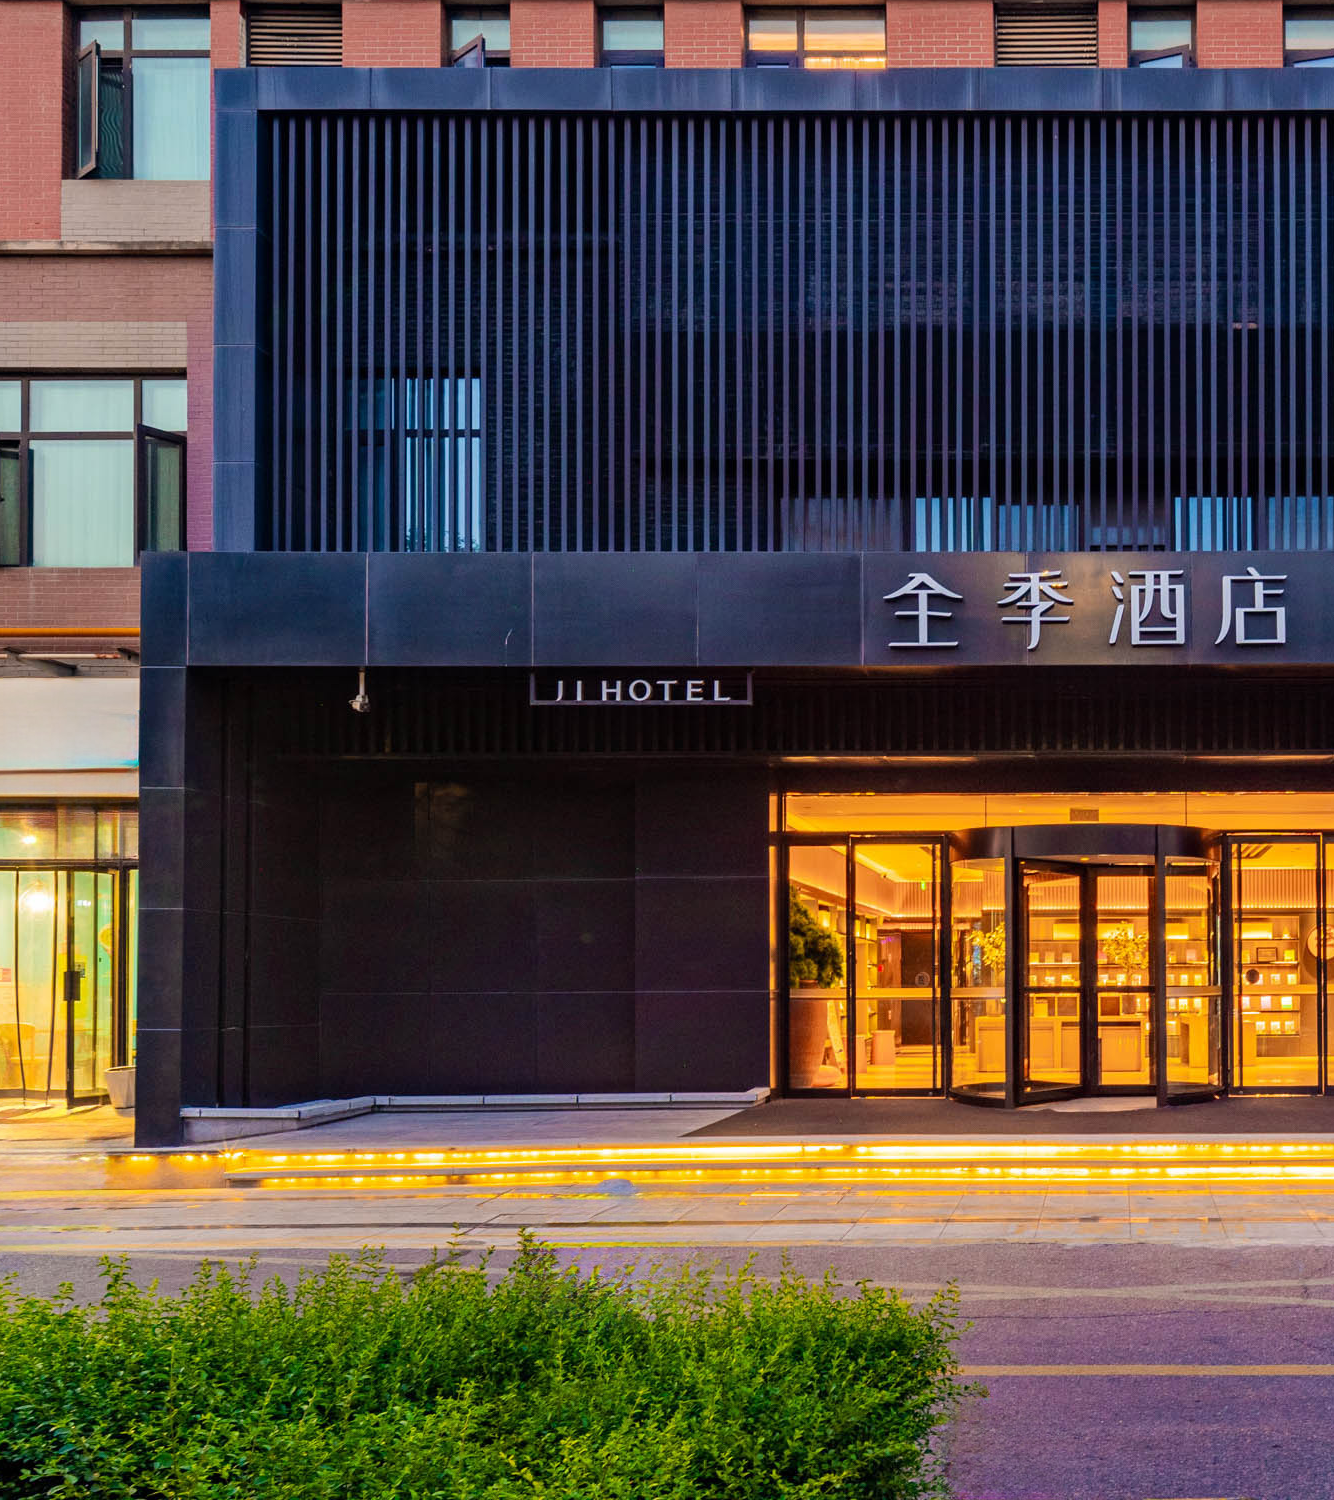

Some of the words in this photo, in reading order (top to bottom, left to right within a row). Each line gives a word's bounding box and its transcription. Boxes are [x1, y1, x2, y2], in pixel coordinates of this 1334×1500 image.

[883, 567, 1287, 651] 全季酒店
[556, 680, 583, 701] JI
[602, 679, 731, 701] HOTEL
